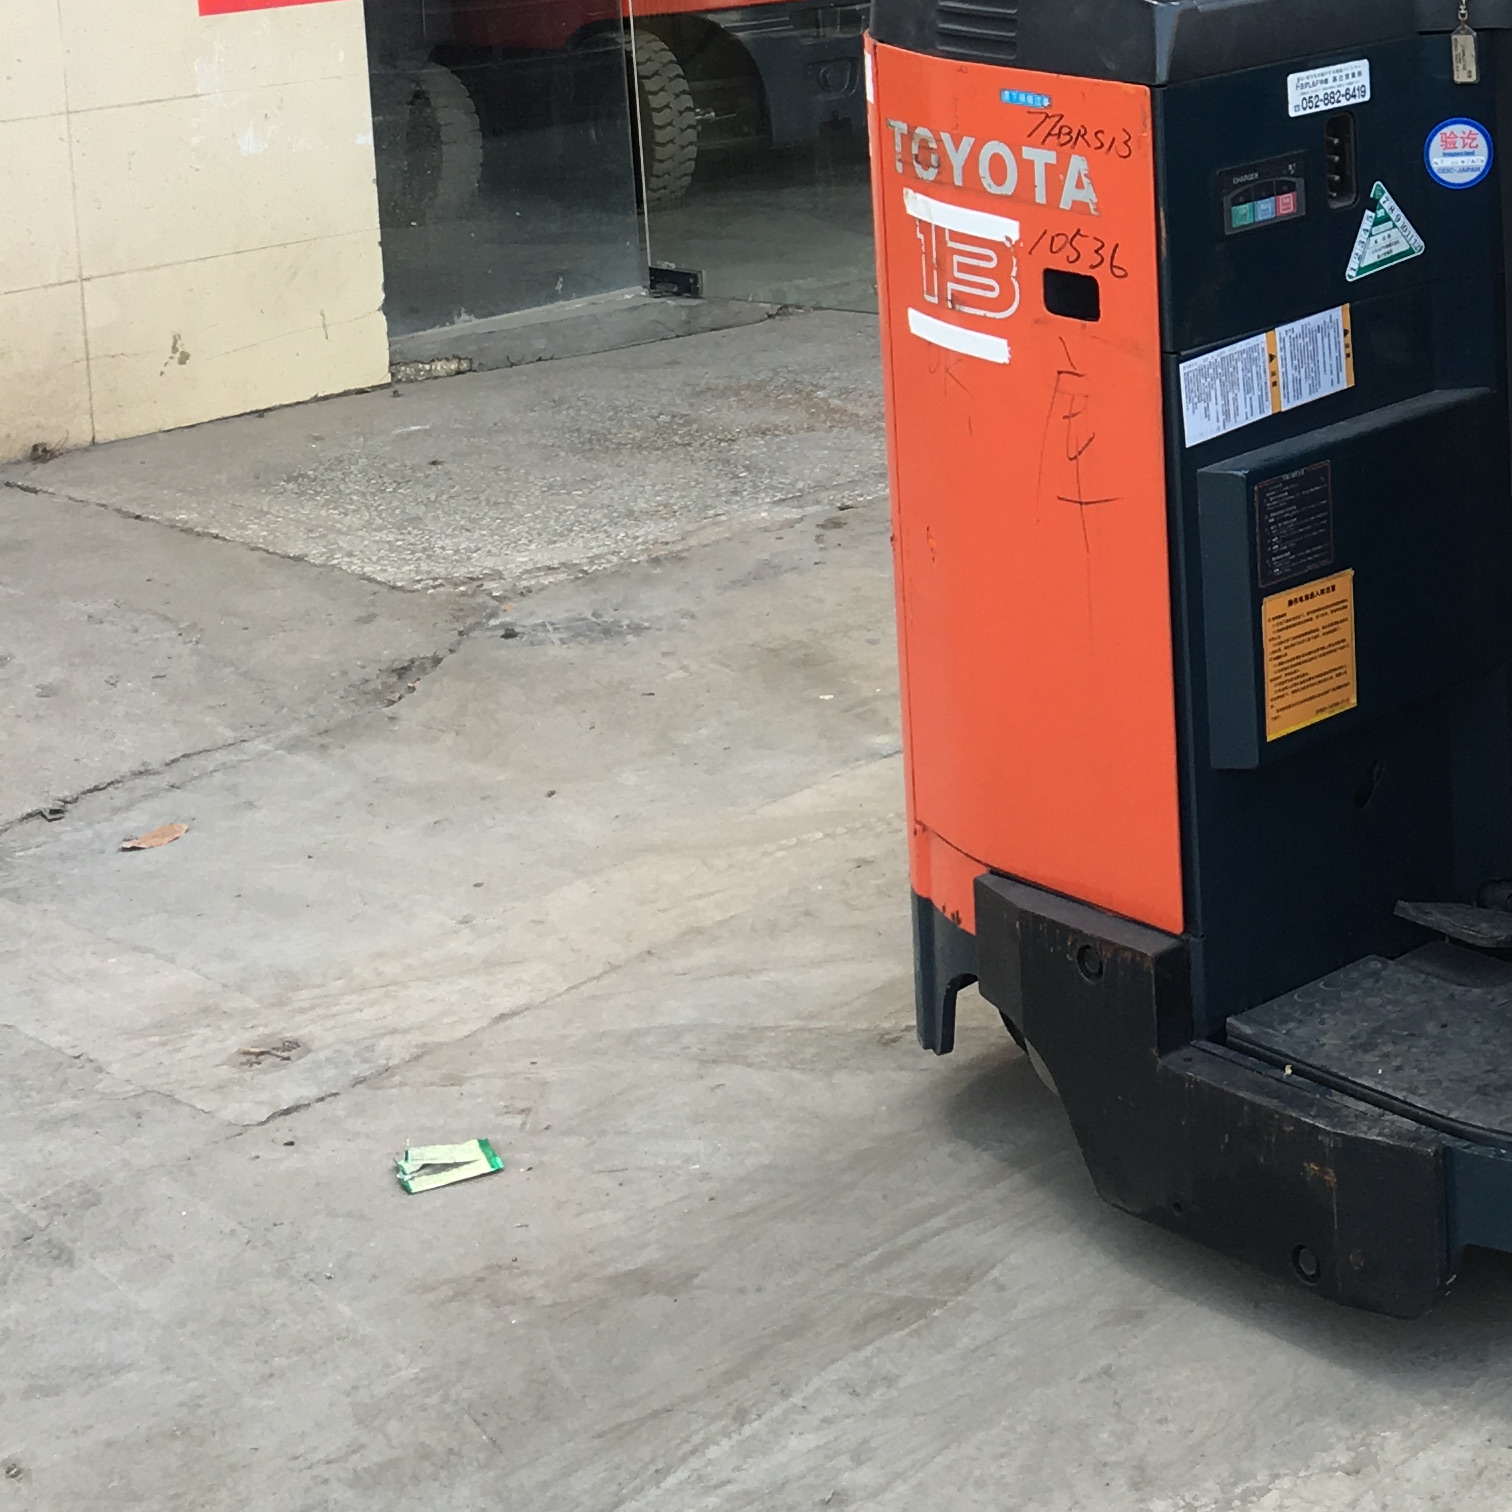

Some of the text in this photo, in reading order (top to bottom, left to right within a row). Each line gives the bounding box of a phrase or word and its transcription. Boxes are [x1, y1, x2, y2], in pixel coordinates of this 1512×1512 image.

[1301, 84, 1367, 111] 052-882-6419
[1440, 130, 1479, 151] 验讫
[887, 118, 1099, 216] TOYOTA
[1028, 228, 1129, 279] 10536
